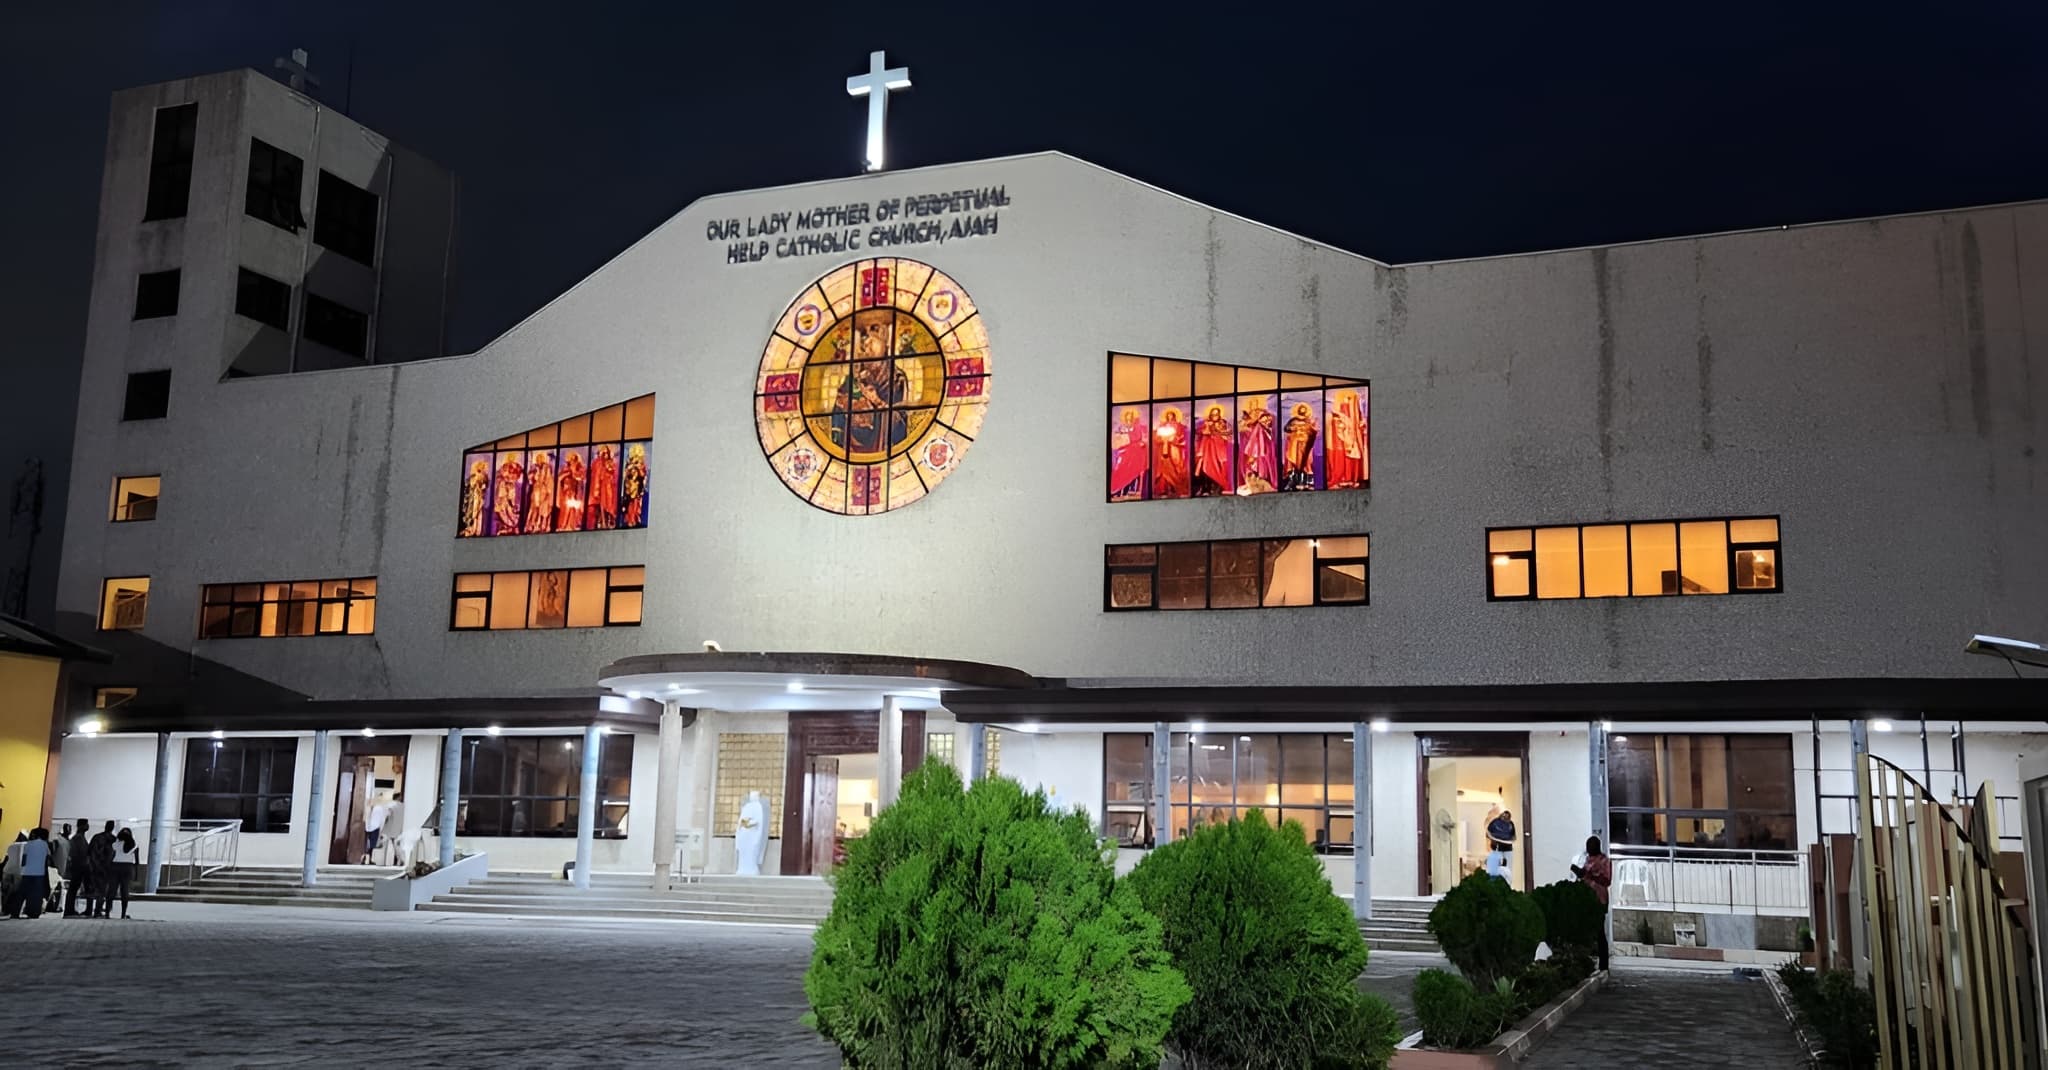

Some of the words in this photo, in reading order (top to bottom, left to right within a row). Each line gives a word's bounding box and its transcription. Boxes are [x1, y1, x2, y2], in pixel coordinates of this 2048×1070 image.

[706, 217, 740, 241] OUR
[747, 211, 792, 237] LADY
[797, 202, 870, 230] MOTHER
[876, 198, 900, 222] OF
[904, 184, 1010, 218] PERPETUAL
[727, 239, 769, 264] HELP
[776, 228, 860, 258] CATHOLIC
